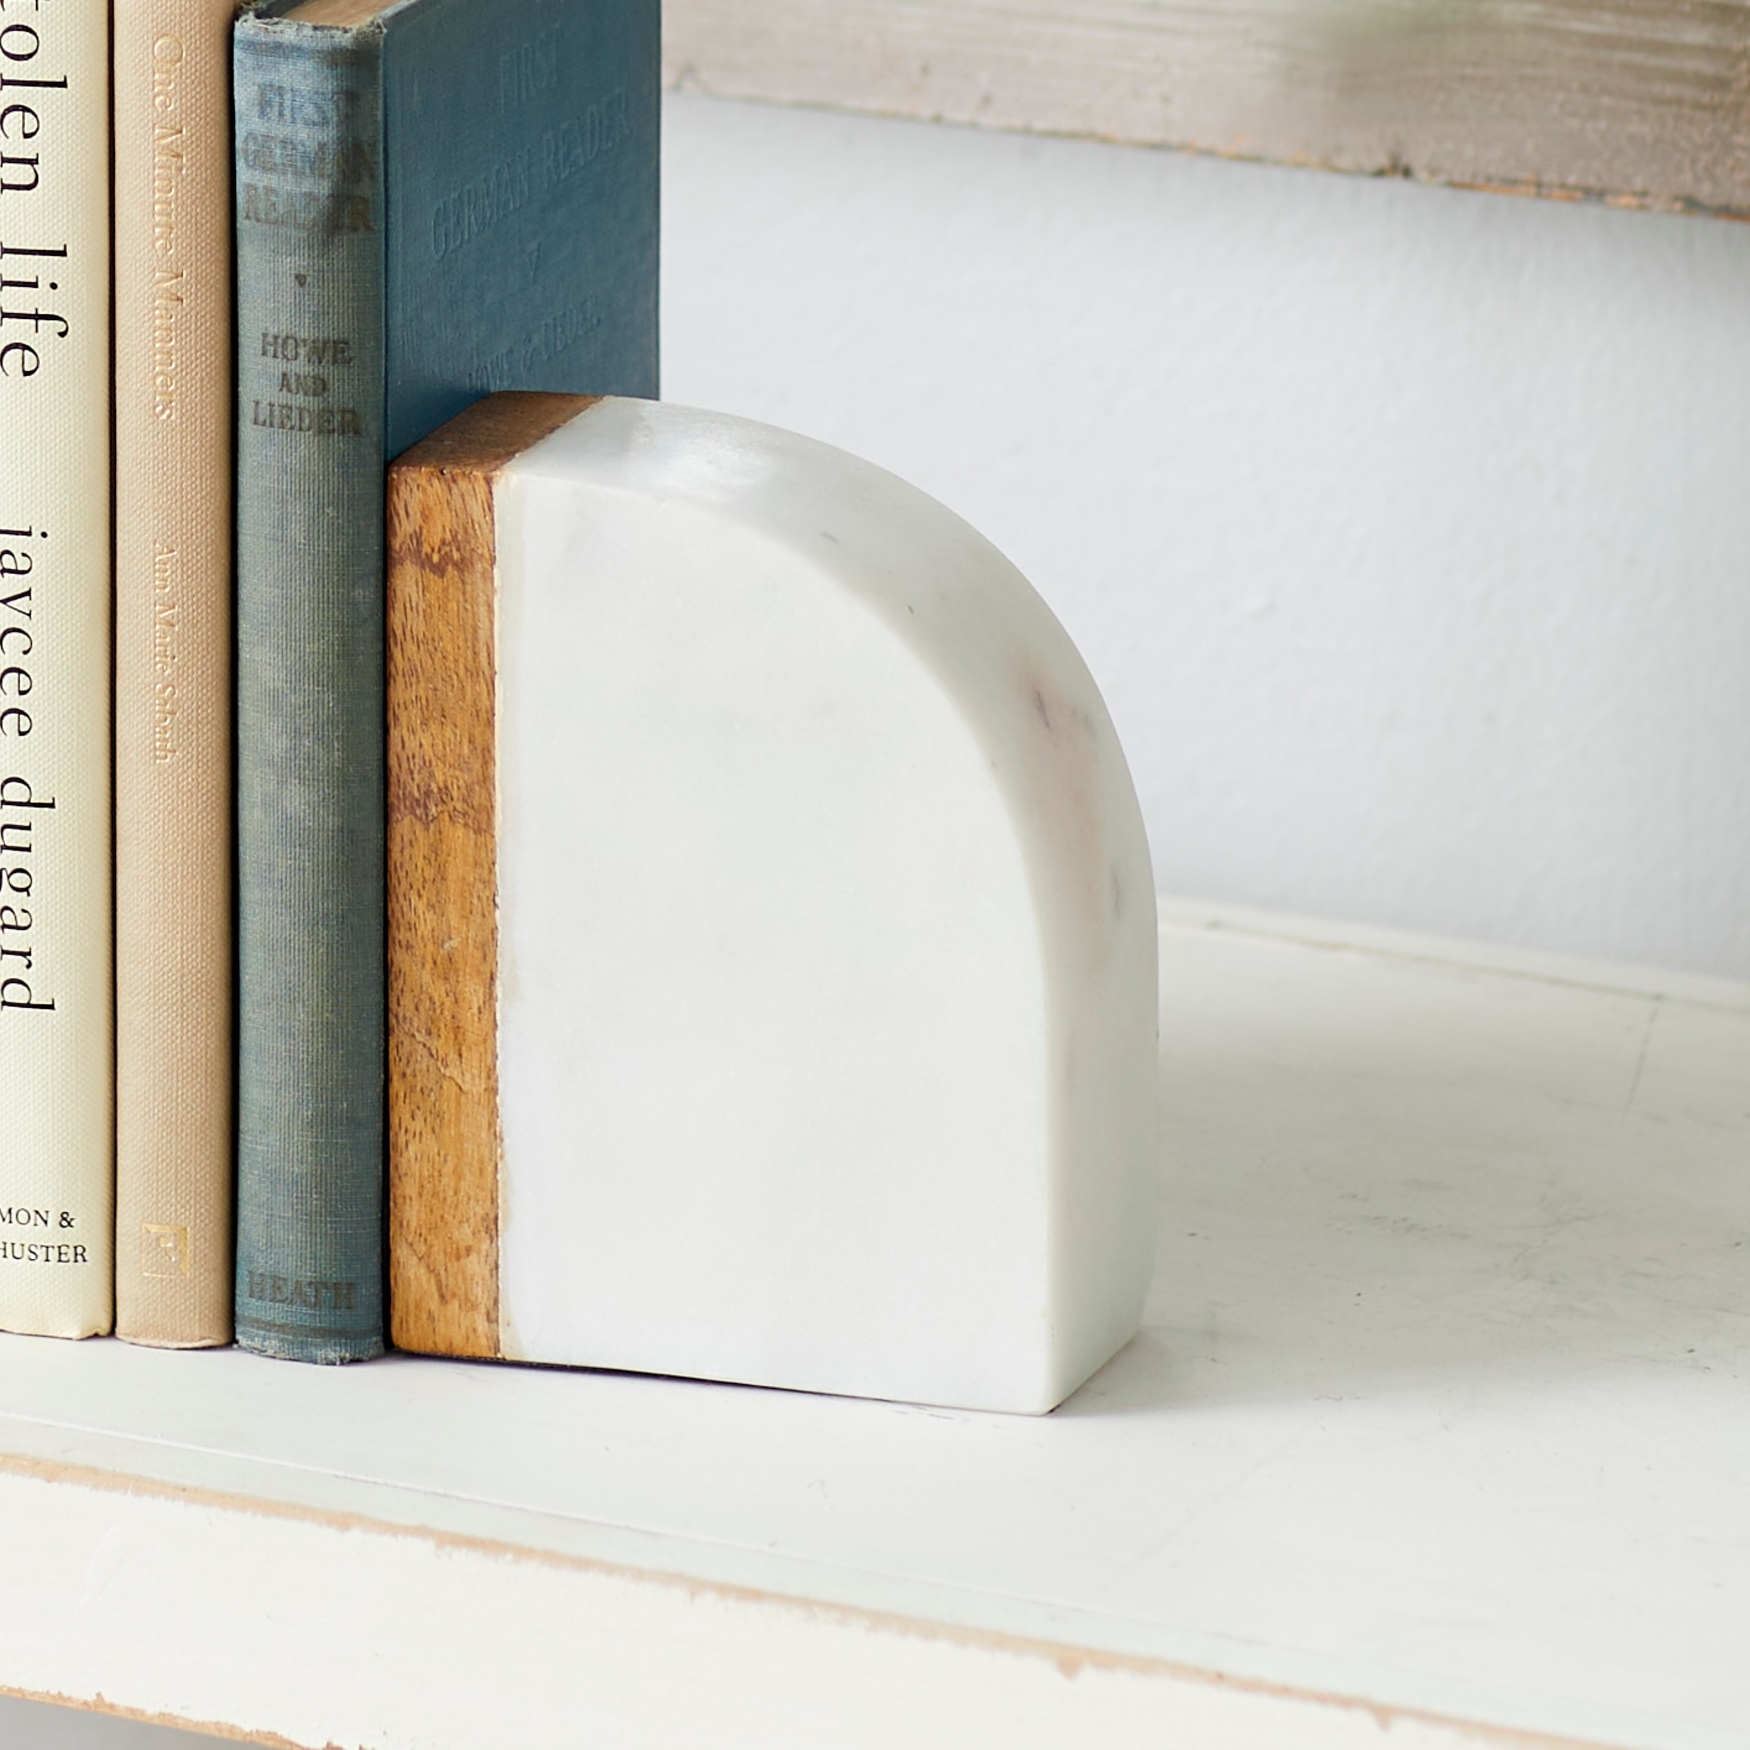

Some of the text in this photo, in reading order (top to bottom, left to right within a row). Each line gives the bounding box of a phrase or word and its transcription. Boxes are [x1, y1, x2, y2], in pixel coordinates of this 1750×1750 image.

[153, 34, 186, 421] One Minute Manners
[260, 331, 357, 366] HOWE
[278, 370, 328, 398] AND
[252, 400, 364, 437] LIEDER
[155, 540, 179, 594] Ann
[155, 602, 179, 675] Marie
[58, 1210, 76, 1229] &
[248, 1270, 357, 1311] HEATH
